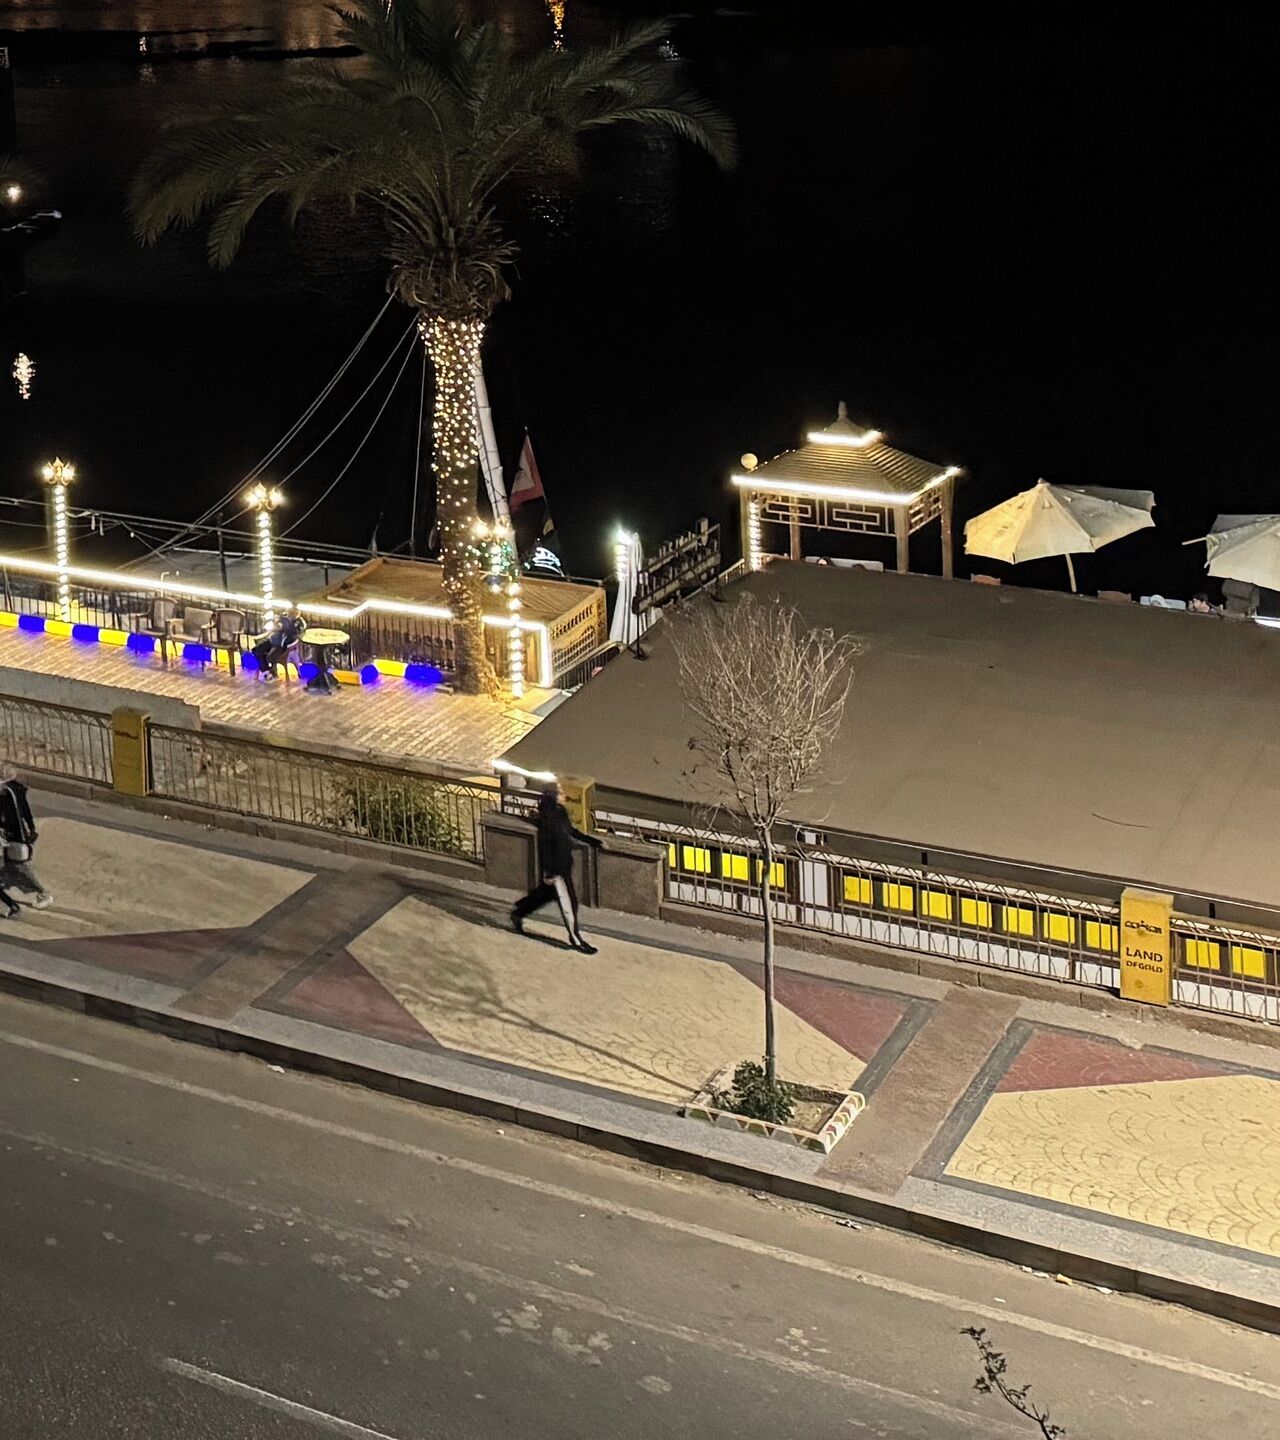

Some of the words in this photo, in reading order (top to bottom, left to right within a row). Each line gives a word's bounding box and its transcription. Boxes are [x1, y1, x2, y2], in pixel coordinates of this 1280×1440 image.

[1126, 947, 1163, 962] LAND
[1126, 960, 1138, 968] OF
[1138, 963, 1163, 973] GOLD
